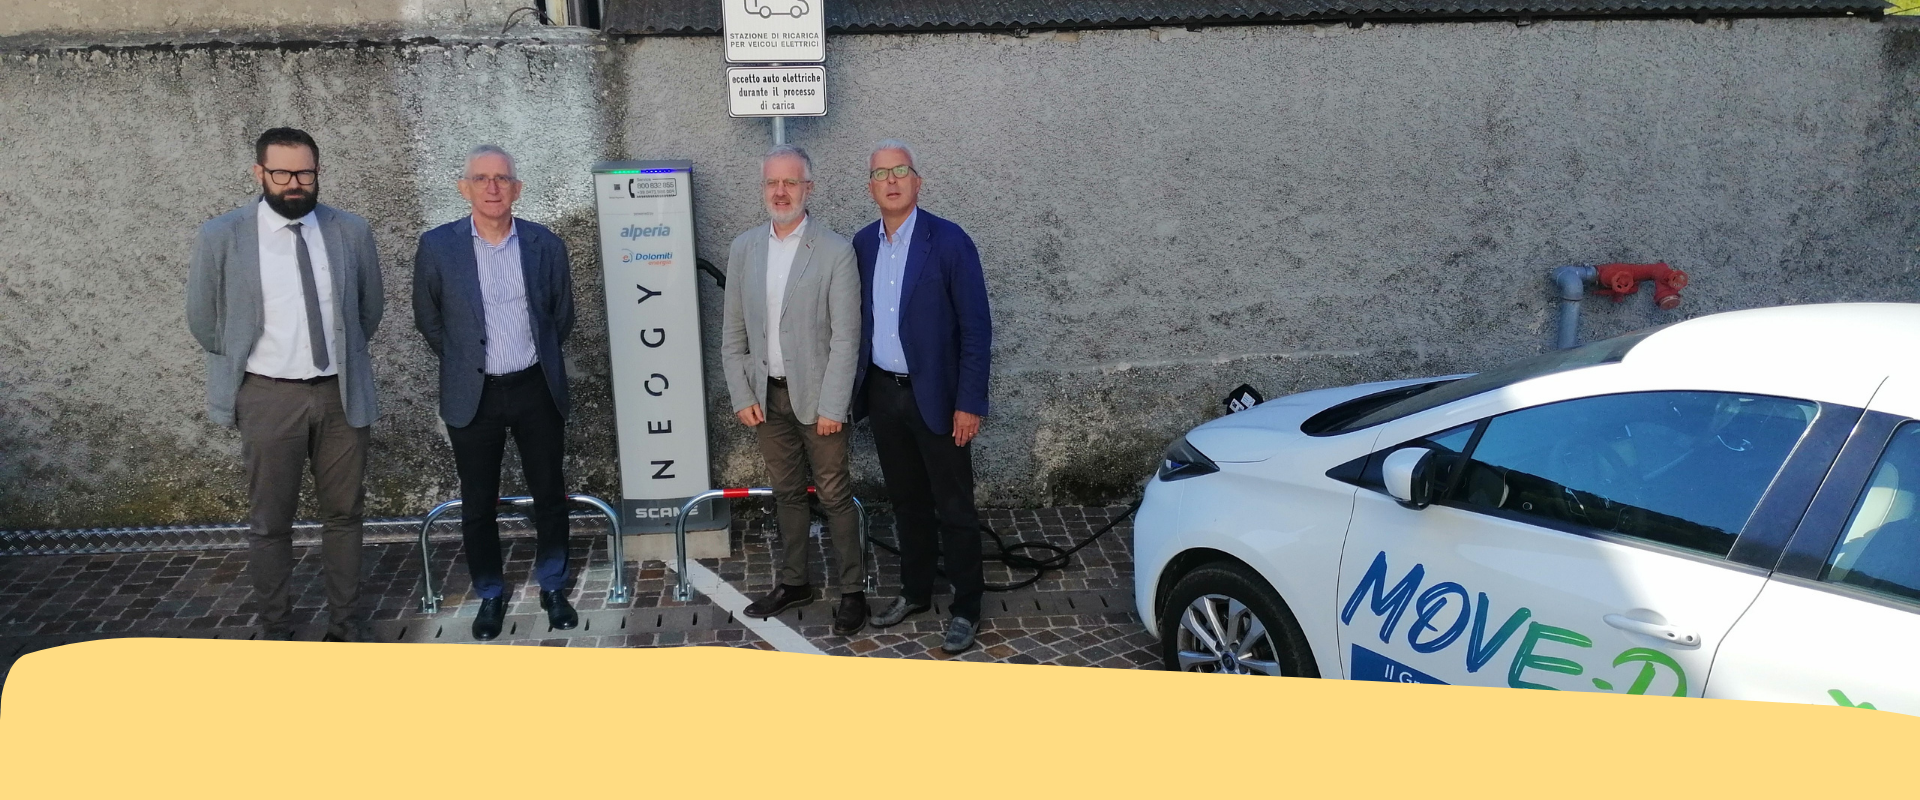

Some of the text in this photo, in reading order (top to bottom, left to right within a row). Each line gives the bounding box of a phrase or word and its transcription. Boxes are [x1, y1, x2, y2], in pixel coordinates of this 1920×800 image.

[732, 73, 821, 83] eccetto auto elettriche
[739, 87, 815, 98] durante il processo
[760, 101, 795, 110] di carica
[620, 223, 671, 241] alperia
[635, 252, 673, 261] Dolomiti
[636, 283, 676, 480] NEOGY
